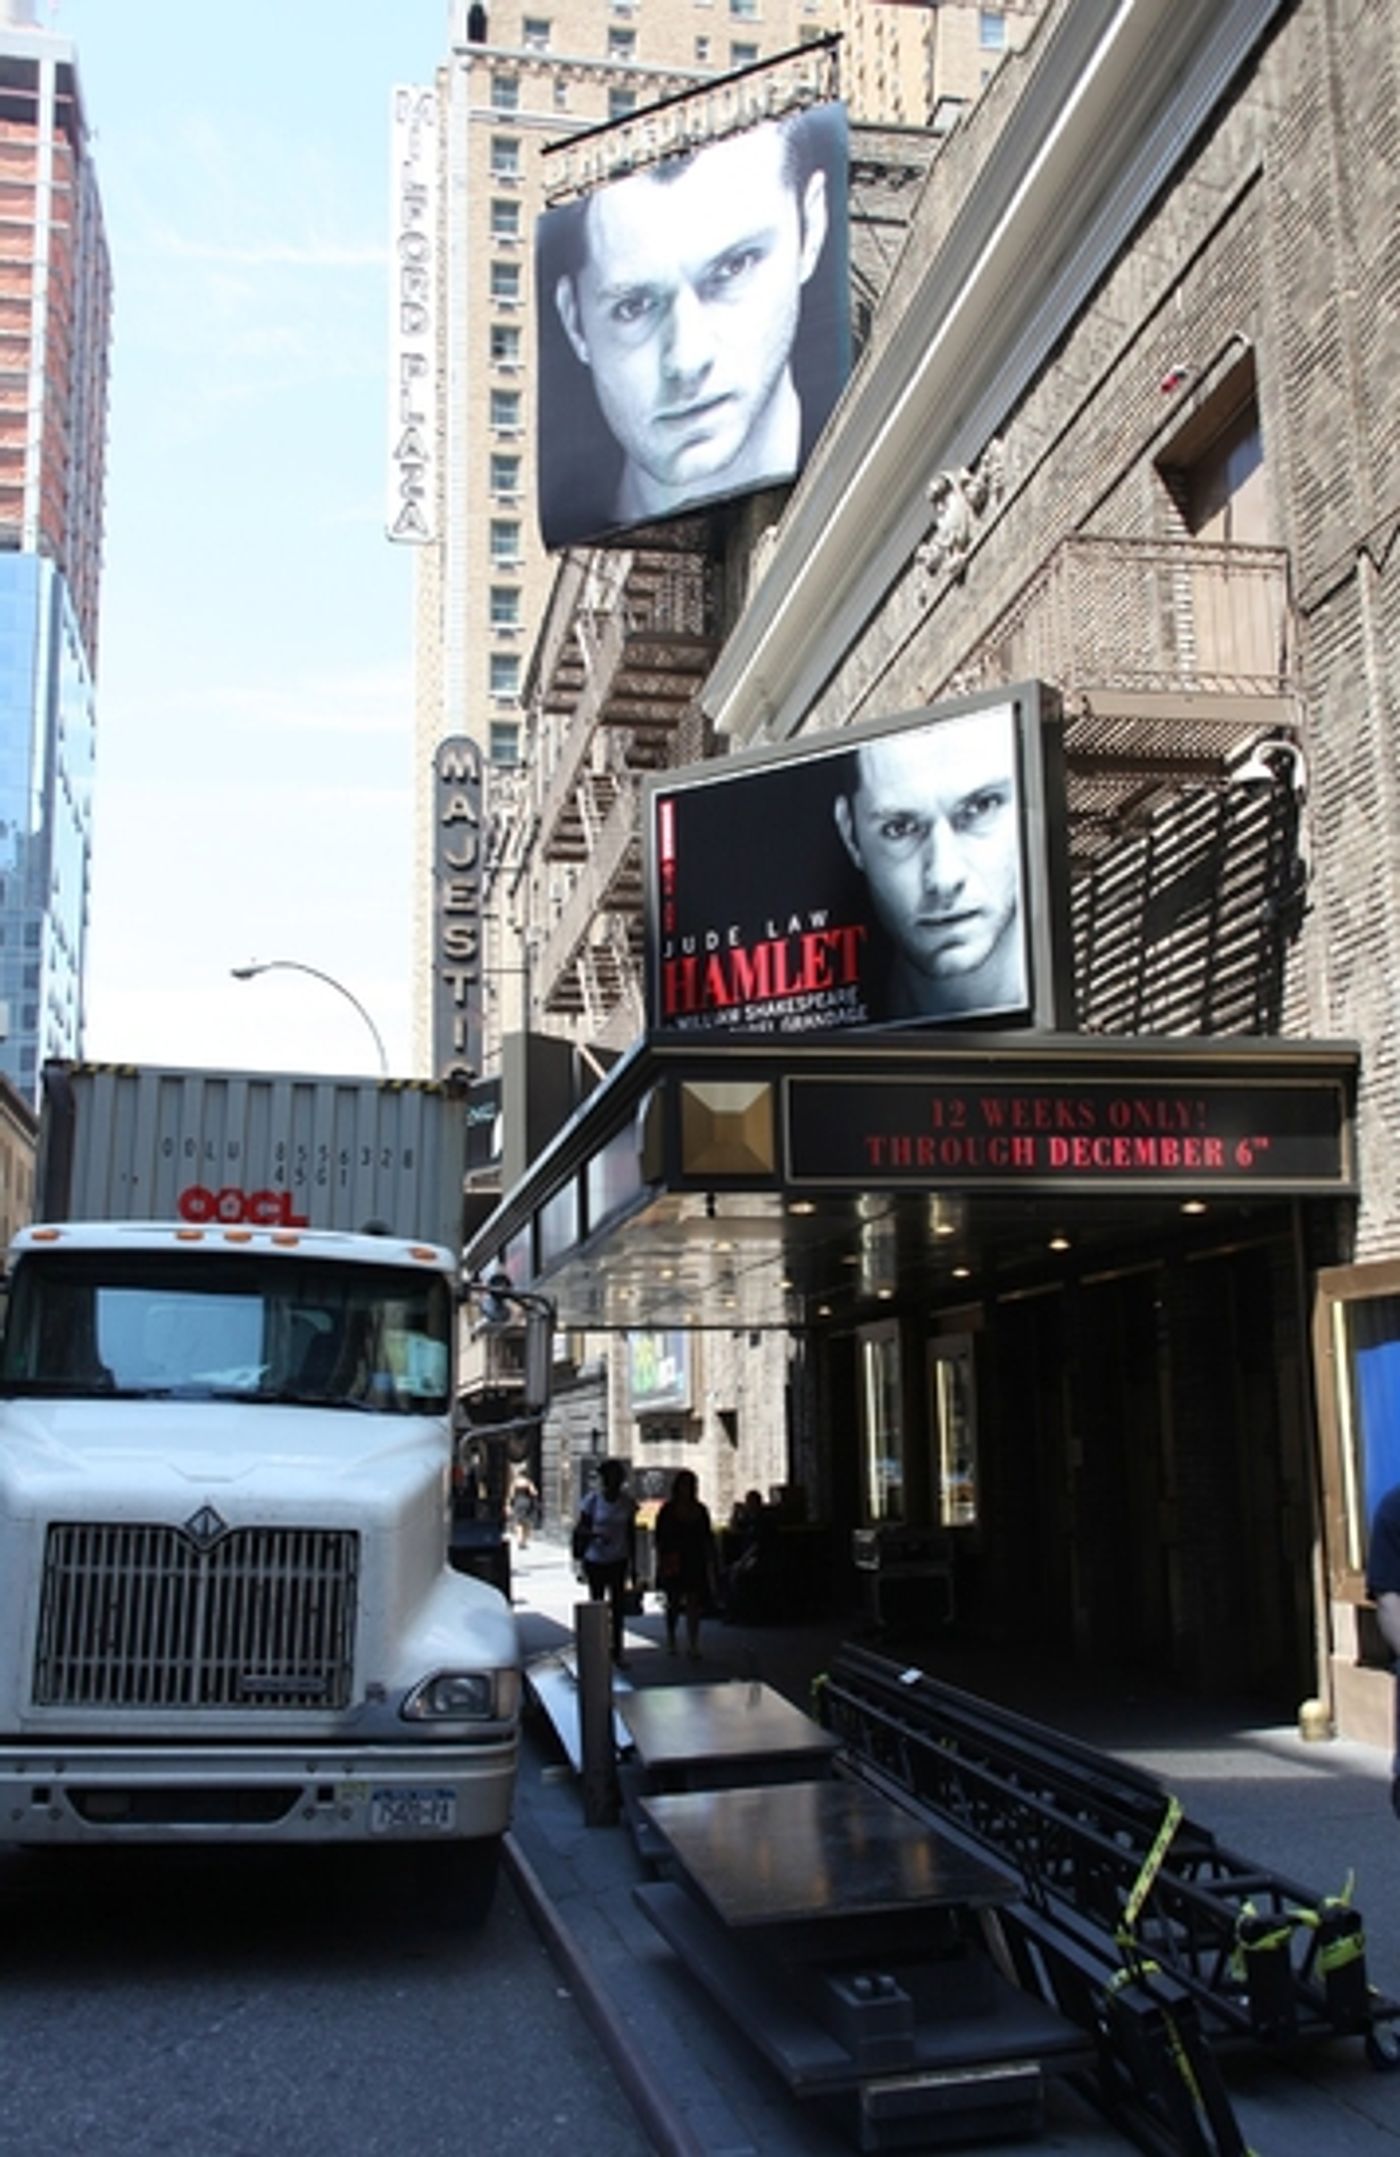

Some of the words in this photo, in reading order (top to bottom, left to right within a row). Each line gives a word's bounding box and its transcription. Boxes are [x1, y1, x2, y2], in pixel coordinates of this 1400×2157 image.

[395, 90, 434, 338] MILFORD
[392, 352, 430, 535] PLAZA
[664, 926, 740, 958] JUDE
[766, 910, 829, 939] LAW
[663, 926, 868, 1017] HAMLET
[929, 1099, 966, 1129] 12
[979, 1099, 1096, 1129] WEEKS
[1108, 1099, 1208, 1130] ONLY!
[866, 1136, 1035, 1166] THROUGH
[1048, 1136, 1223, 1167] DECEMBER
[179, 1184, 309, 1228] OOCL
